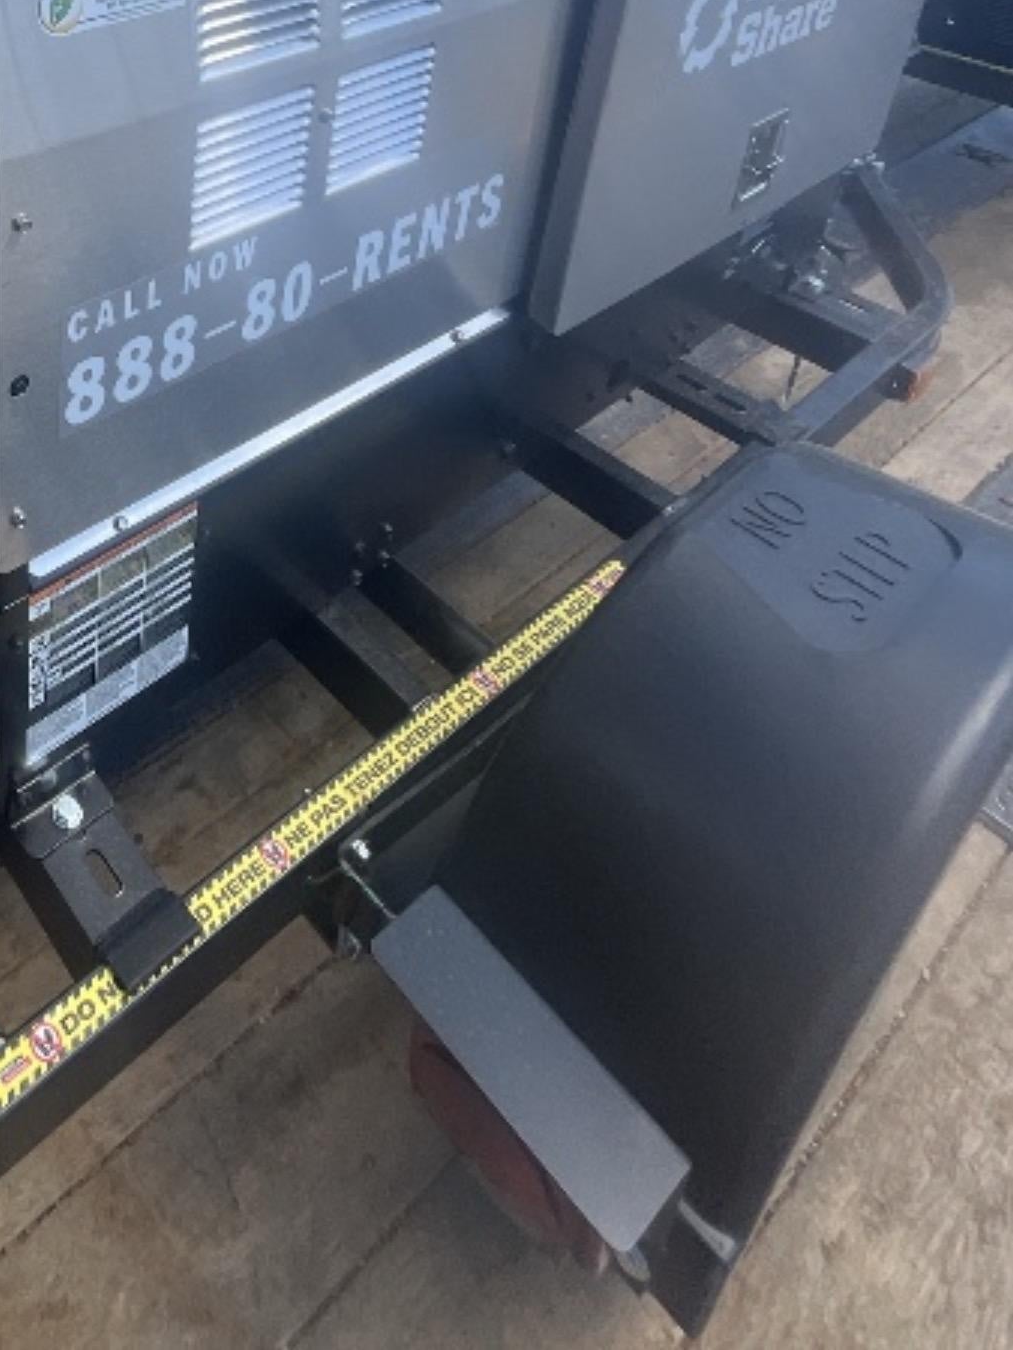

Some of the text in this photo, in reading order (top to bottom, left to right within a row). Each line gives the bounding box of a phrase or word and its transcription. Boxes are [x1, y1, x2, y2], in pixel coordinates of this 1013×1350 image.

[68, 236, 257, 342] CALL NOW
[729, 491, 807, 550] NO
[59, 999, 97, 1036] DO
